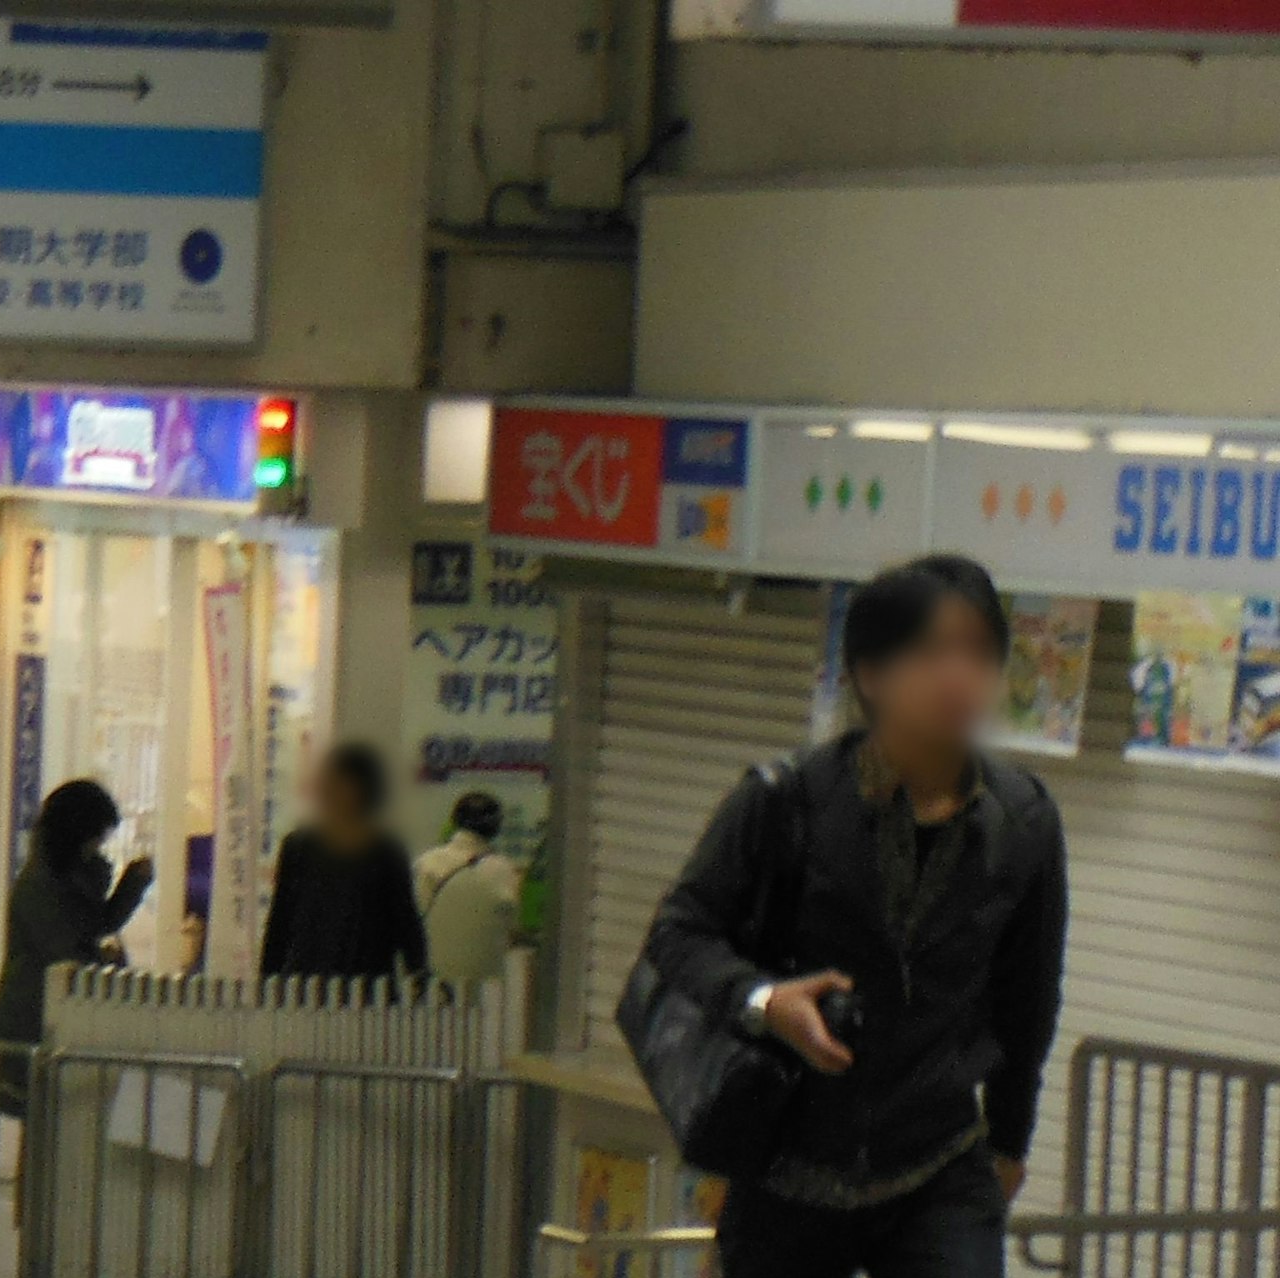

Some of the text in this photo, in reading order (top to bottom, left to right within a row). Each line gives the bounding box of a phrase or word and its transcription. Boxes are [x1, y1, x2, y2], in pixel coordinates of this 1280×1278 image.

[521, 431, 632, 524] 宝くじ
[1114, 465, 1280, 560] SEIBU
